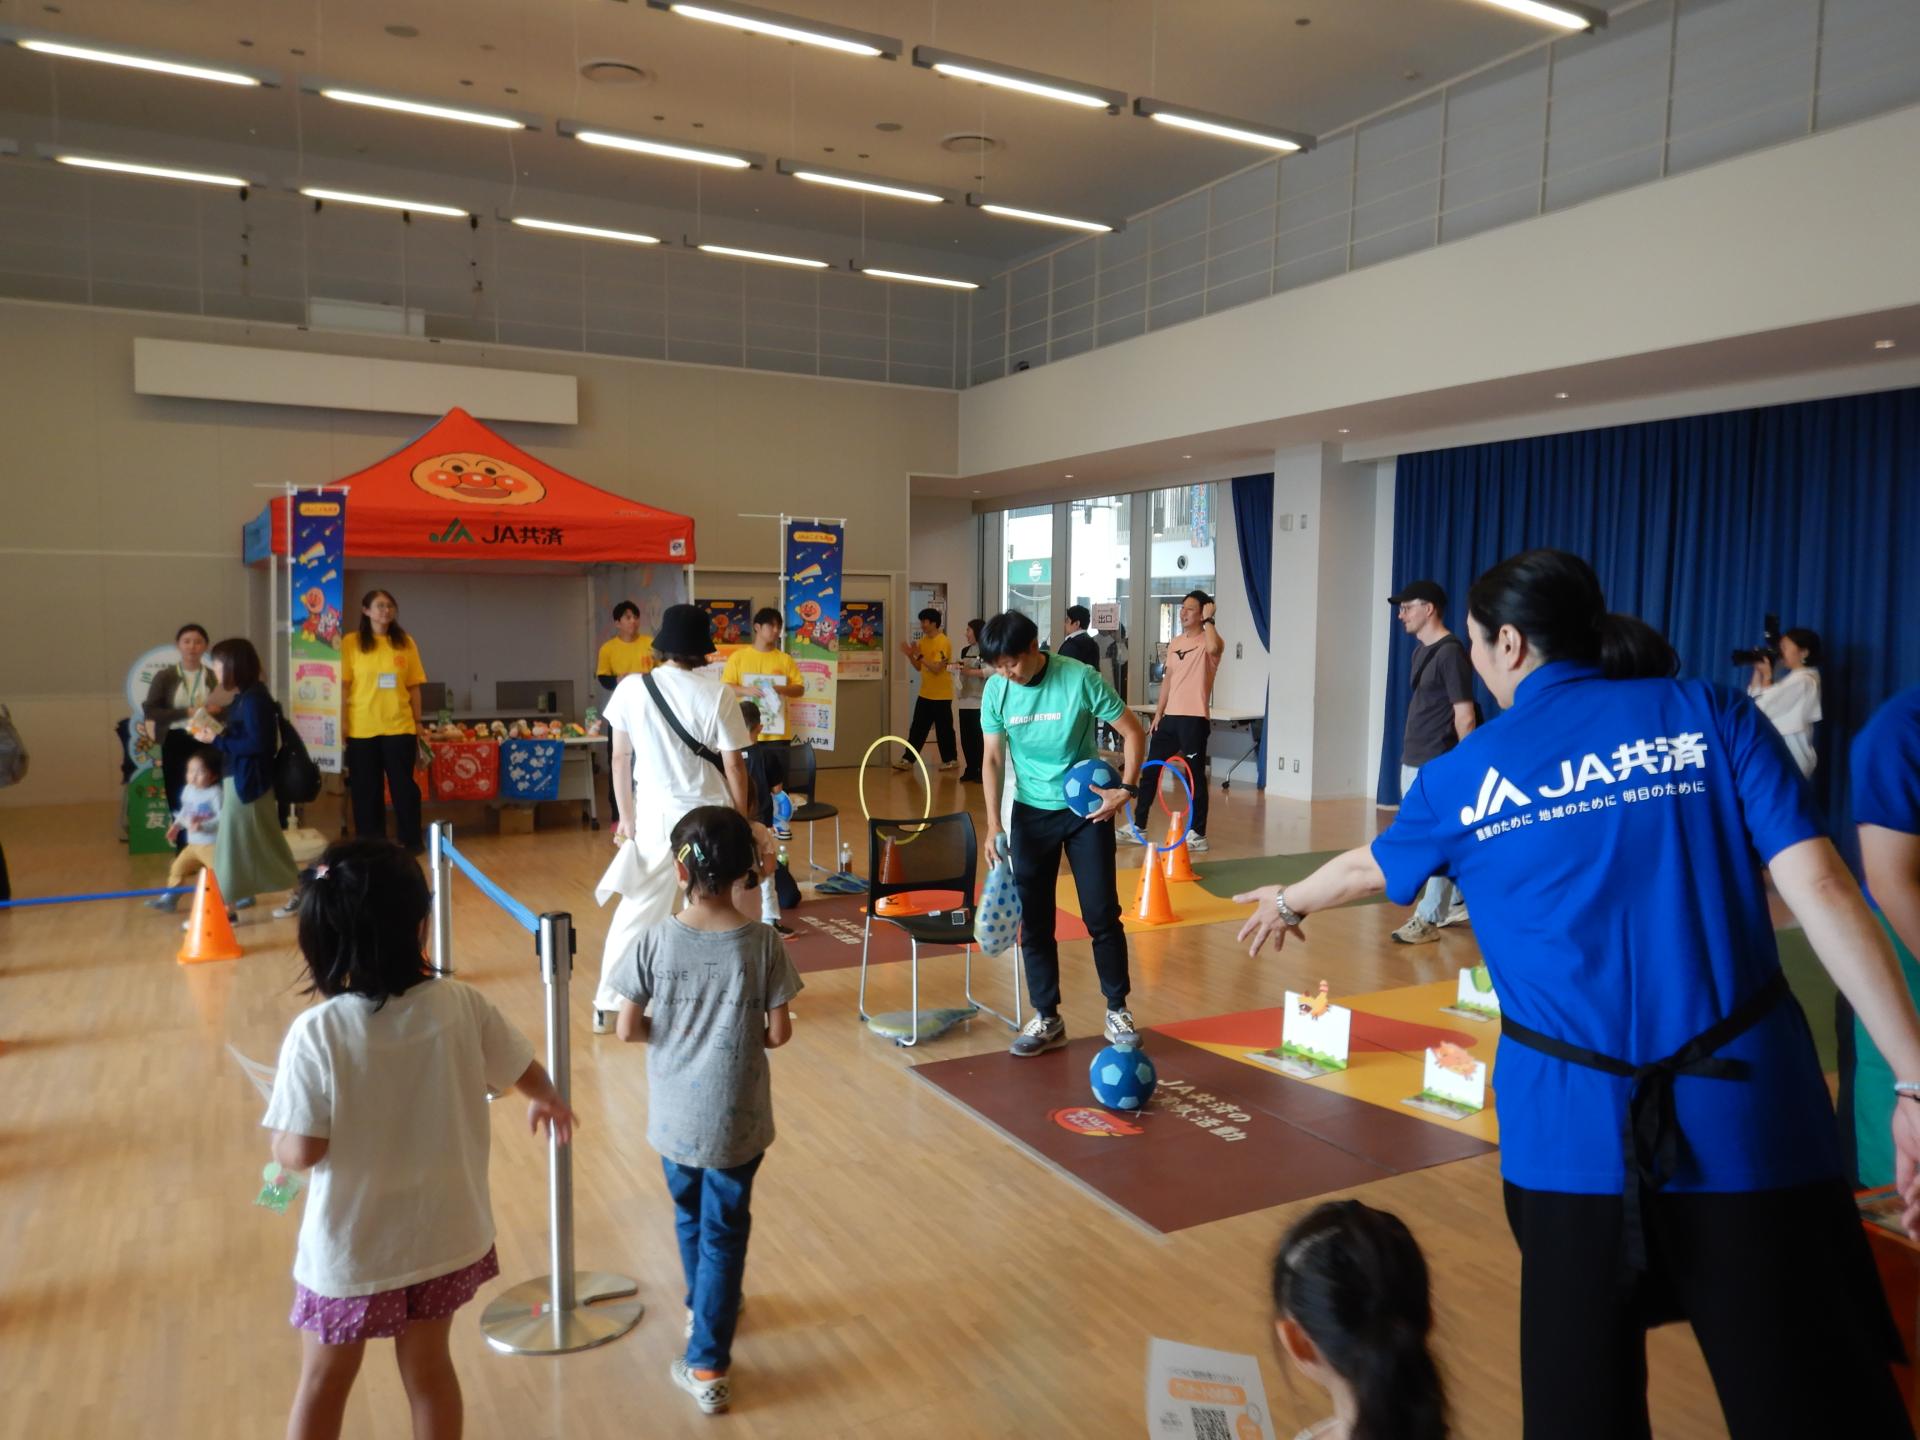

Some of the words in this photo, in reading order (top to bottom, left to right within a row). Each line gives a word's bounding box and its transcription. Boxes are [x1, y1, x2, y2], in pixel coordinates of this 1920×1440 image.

[481, 524, 564, 545] JA共済
[1098, 614, 1113, 624] 出口
[1034, 712, 1062, 722] BEYOND
[803, 737, 829, 745] JA共済
[1538, 731, 1708, 799] JA共済
[1538, 795, 1617, 822] 地域のために
[1622, 780, 1707, 803] 明日のために
[1156, 1079, 1253, 1123] JA共済の
